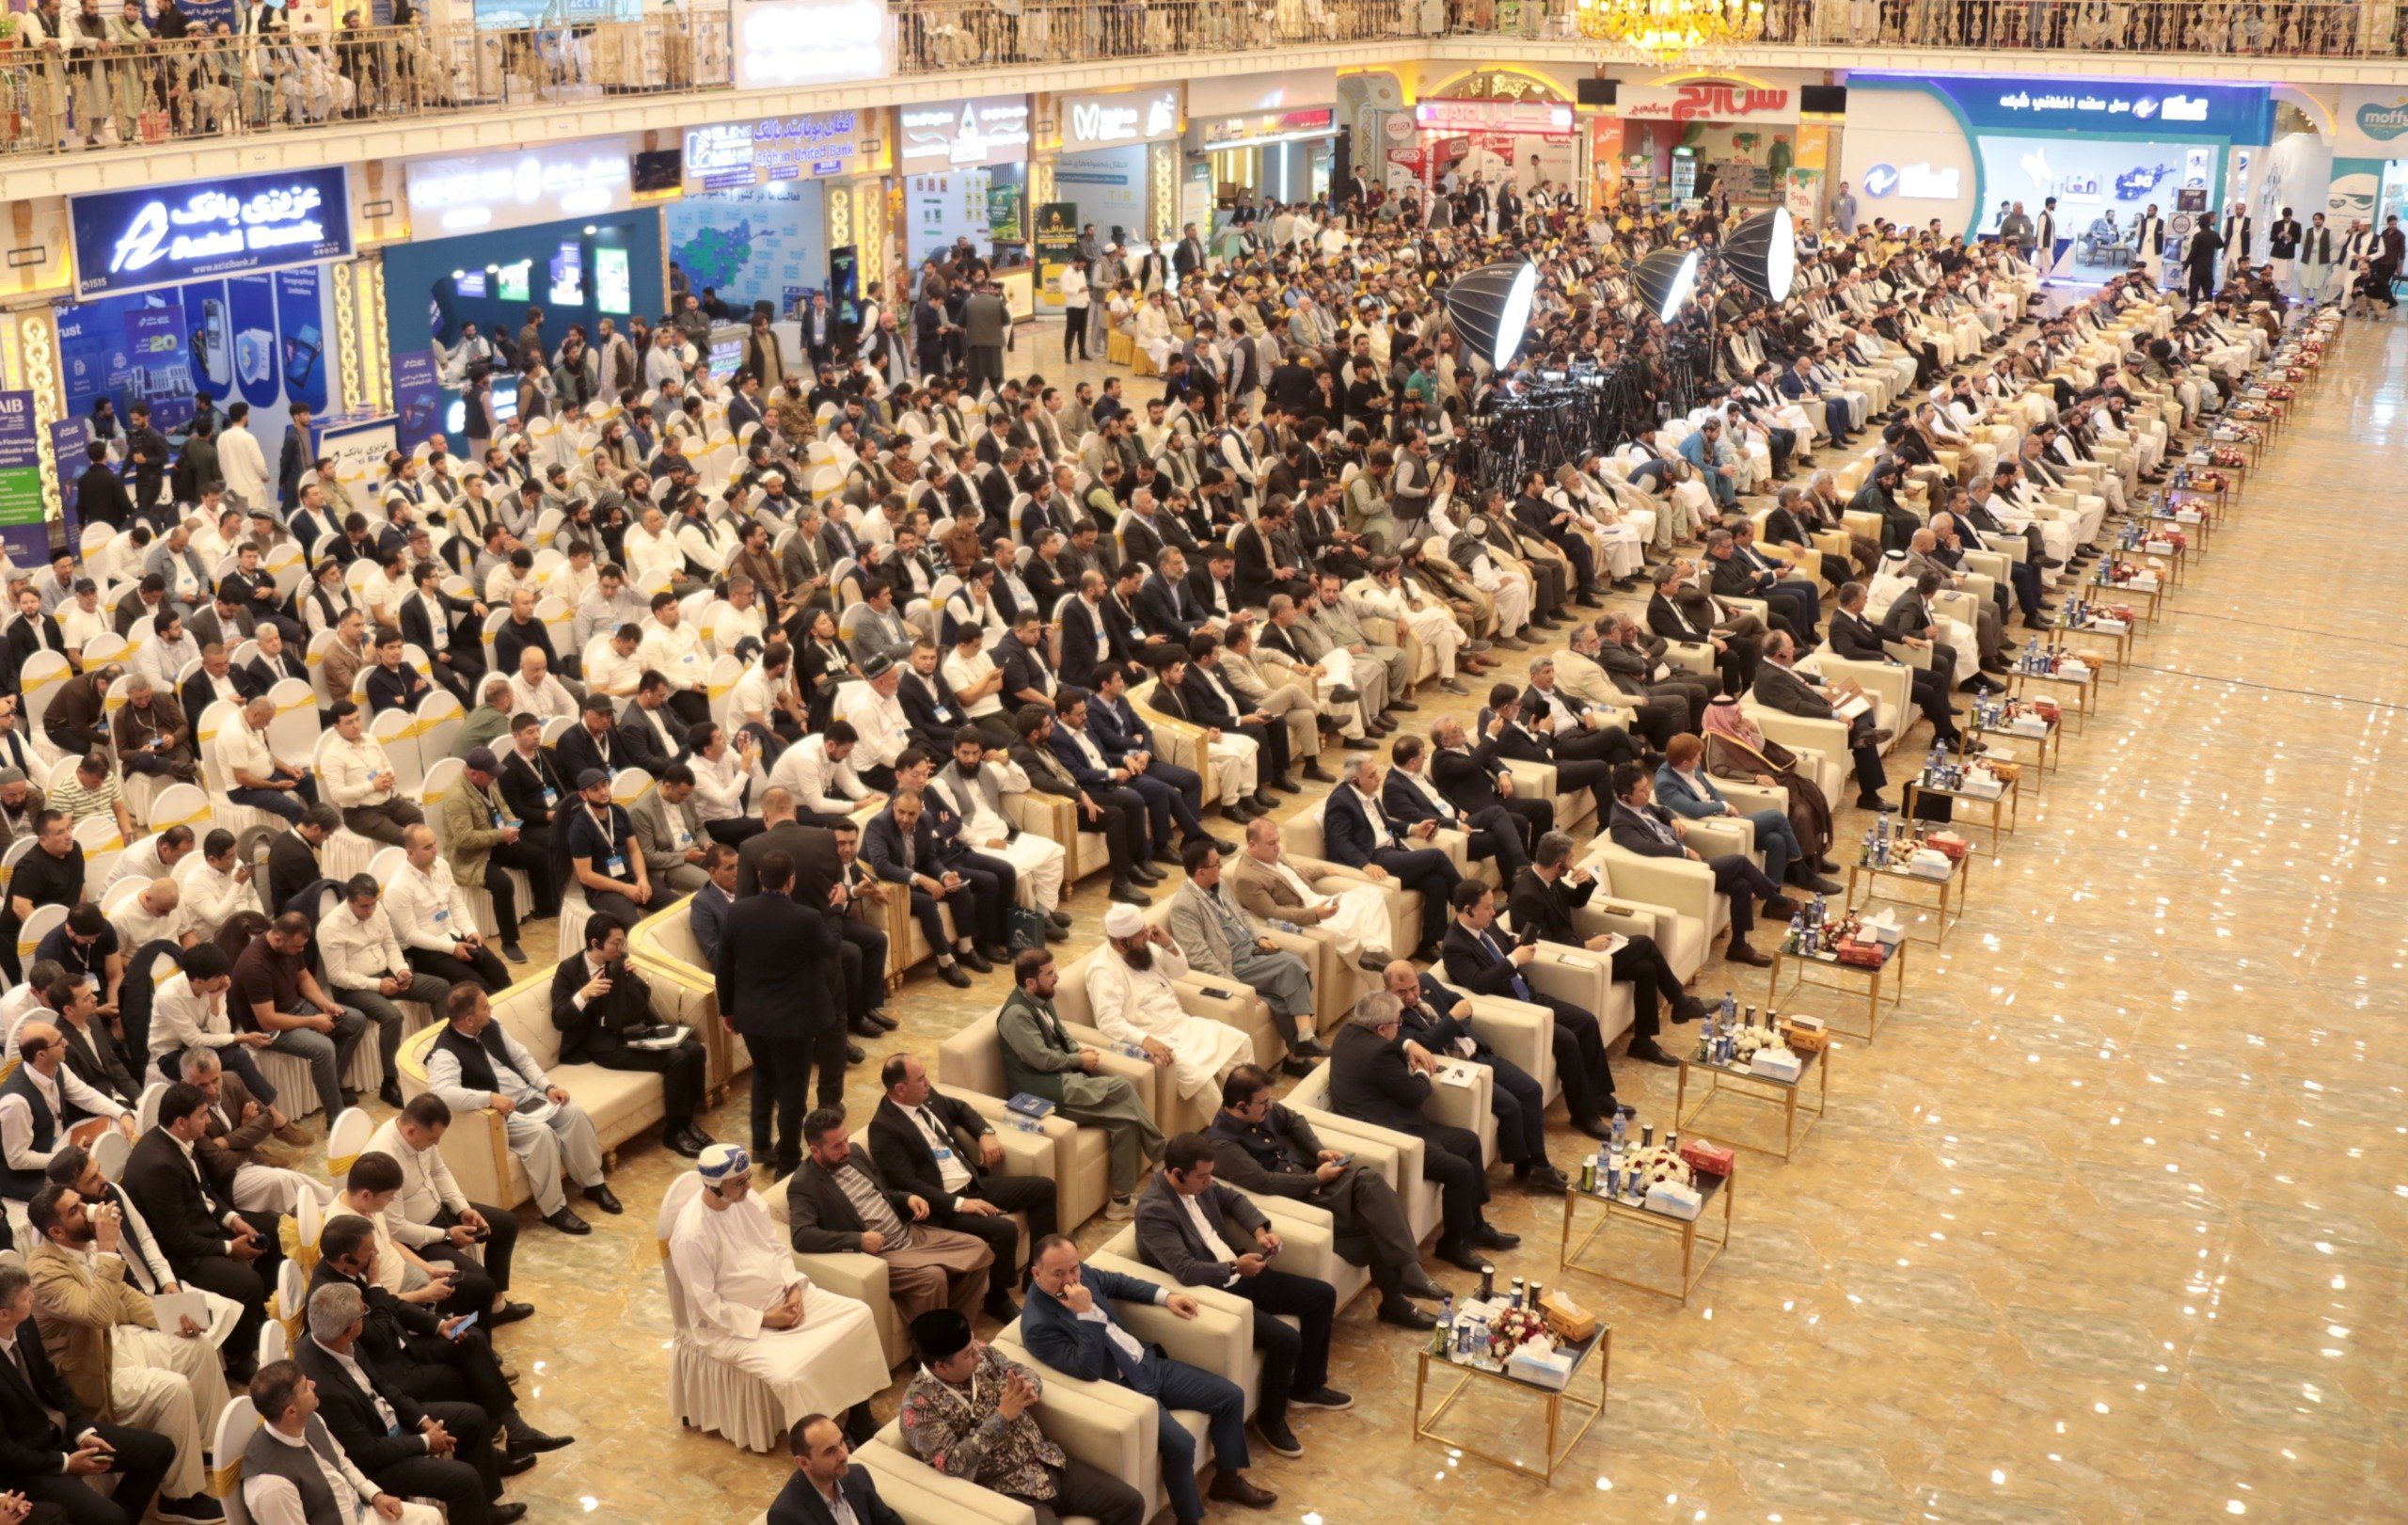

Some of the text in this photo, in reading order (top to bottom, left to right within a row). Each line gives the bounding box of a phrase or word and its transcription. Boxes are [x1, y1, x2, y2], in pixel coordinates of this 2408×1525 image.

[754, 141, 854, 167] Afghan United Bank
[170, 186, 321, 226] عزیزی بانک
[192, 256, 259, 275] www.azizibank.af
[88, 277, 107, 288] 1515
[58, 324, 82, 338] rust
[150, 334, 177, 353] 20
